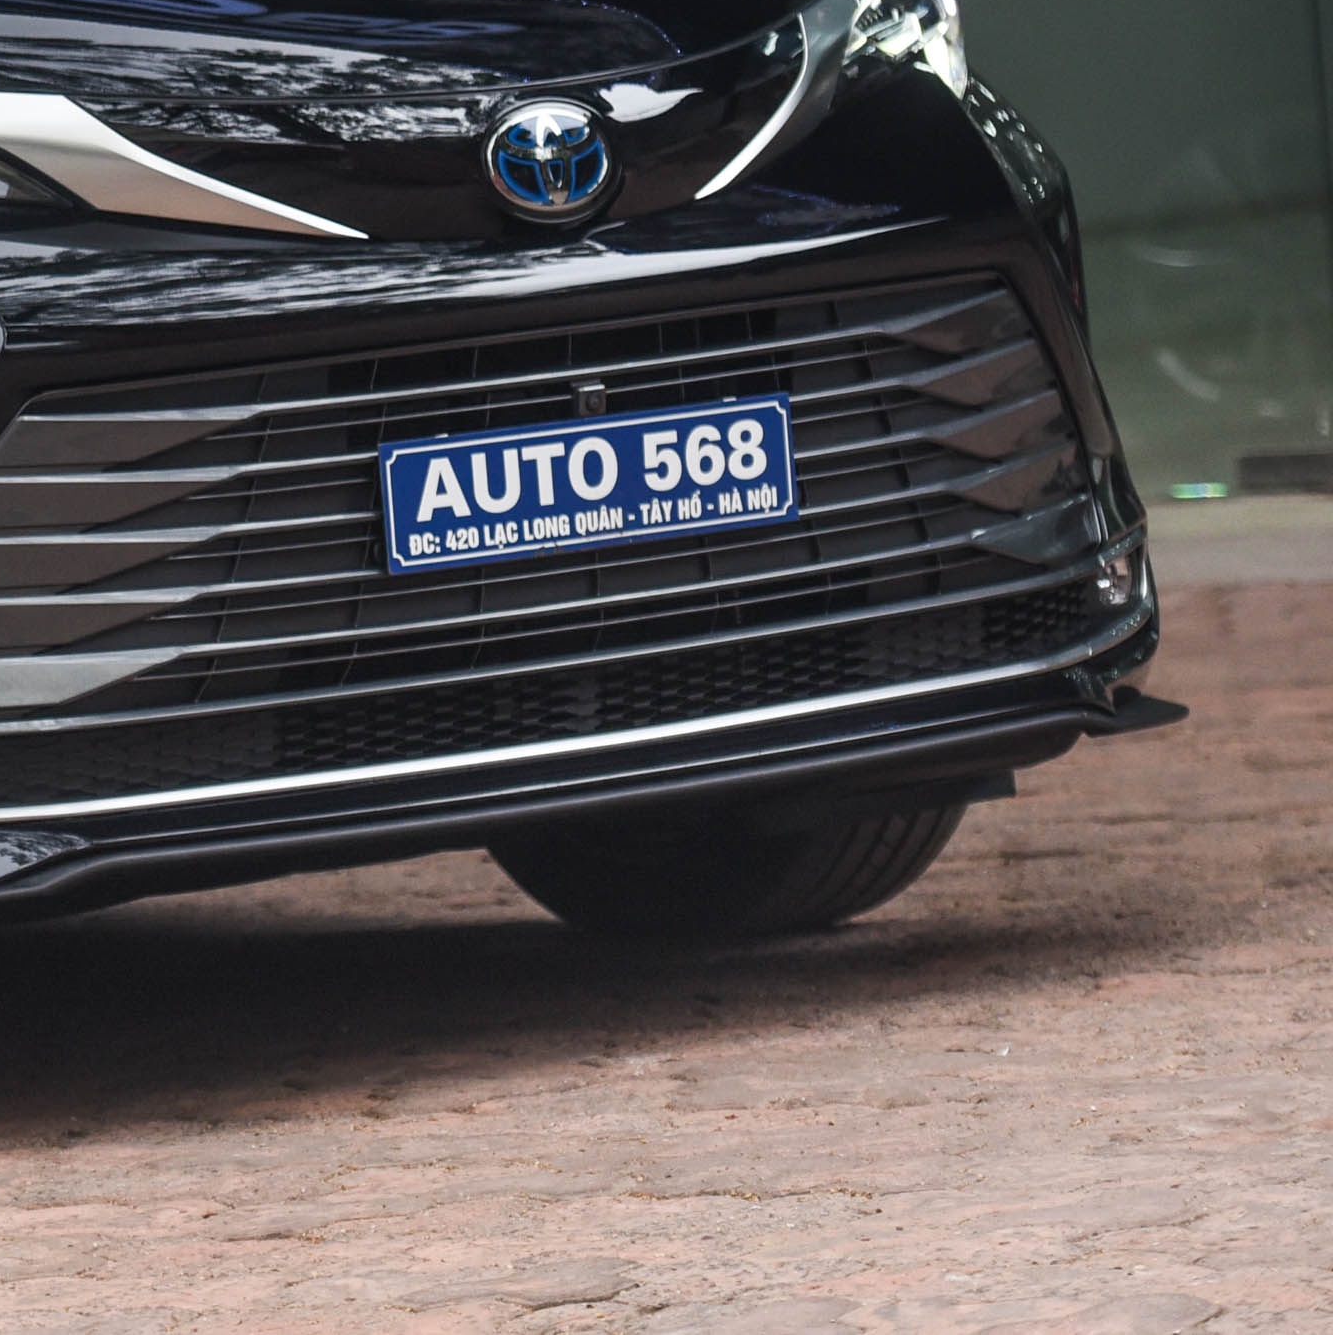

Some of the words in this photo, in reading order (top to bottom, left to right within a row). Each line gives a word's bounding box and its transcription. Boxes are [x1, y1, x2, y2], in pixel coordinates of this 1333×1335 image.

[415, 437, 619, 523] AUTO
[642, 419, 768, 493] 568
[408, 532, 441, 557] ĐC:
[445, 526, 480, 552] 420
[484, 521, 519, 550] LẠC
[523, 514, 571, 541] LONG
[575, 505, 623, 536] QUÂN
[640, 498, 673, 526] TÂY
[719, 486, 744, 515] HÀ
[747, 483, 779, 514] NỘI
